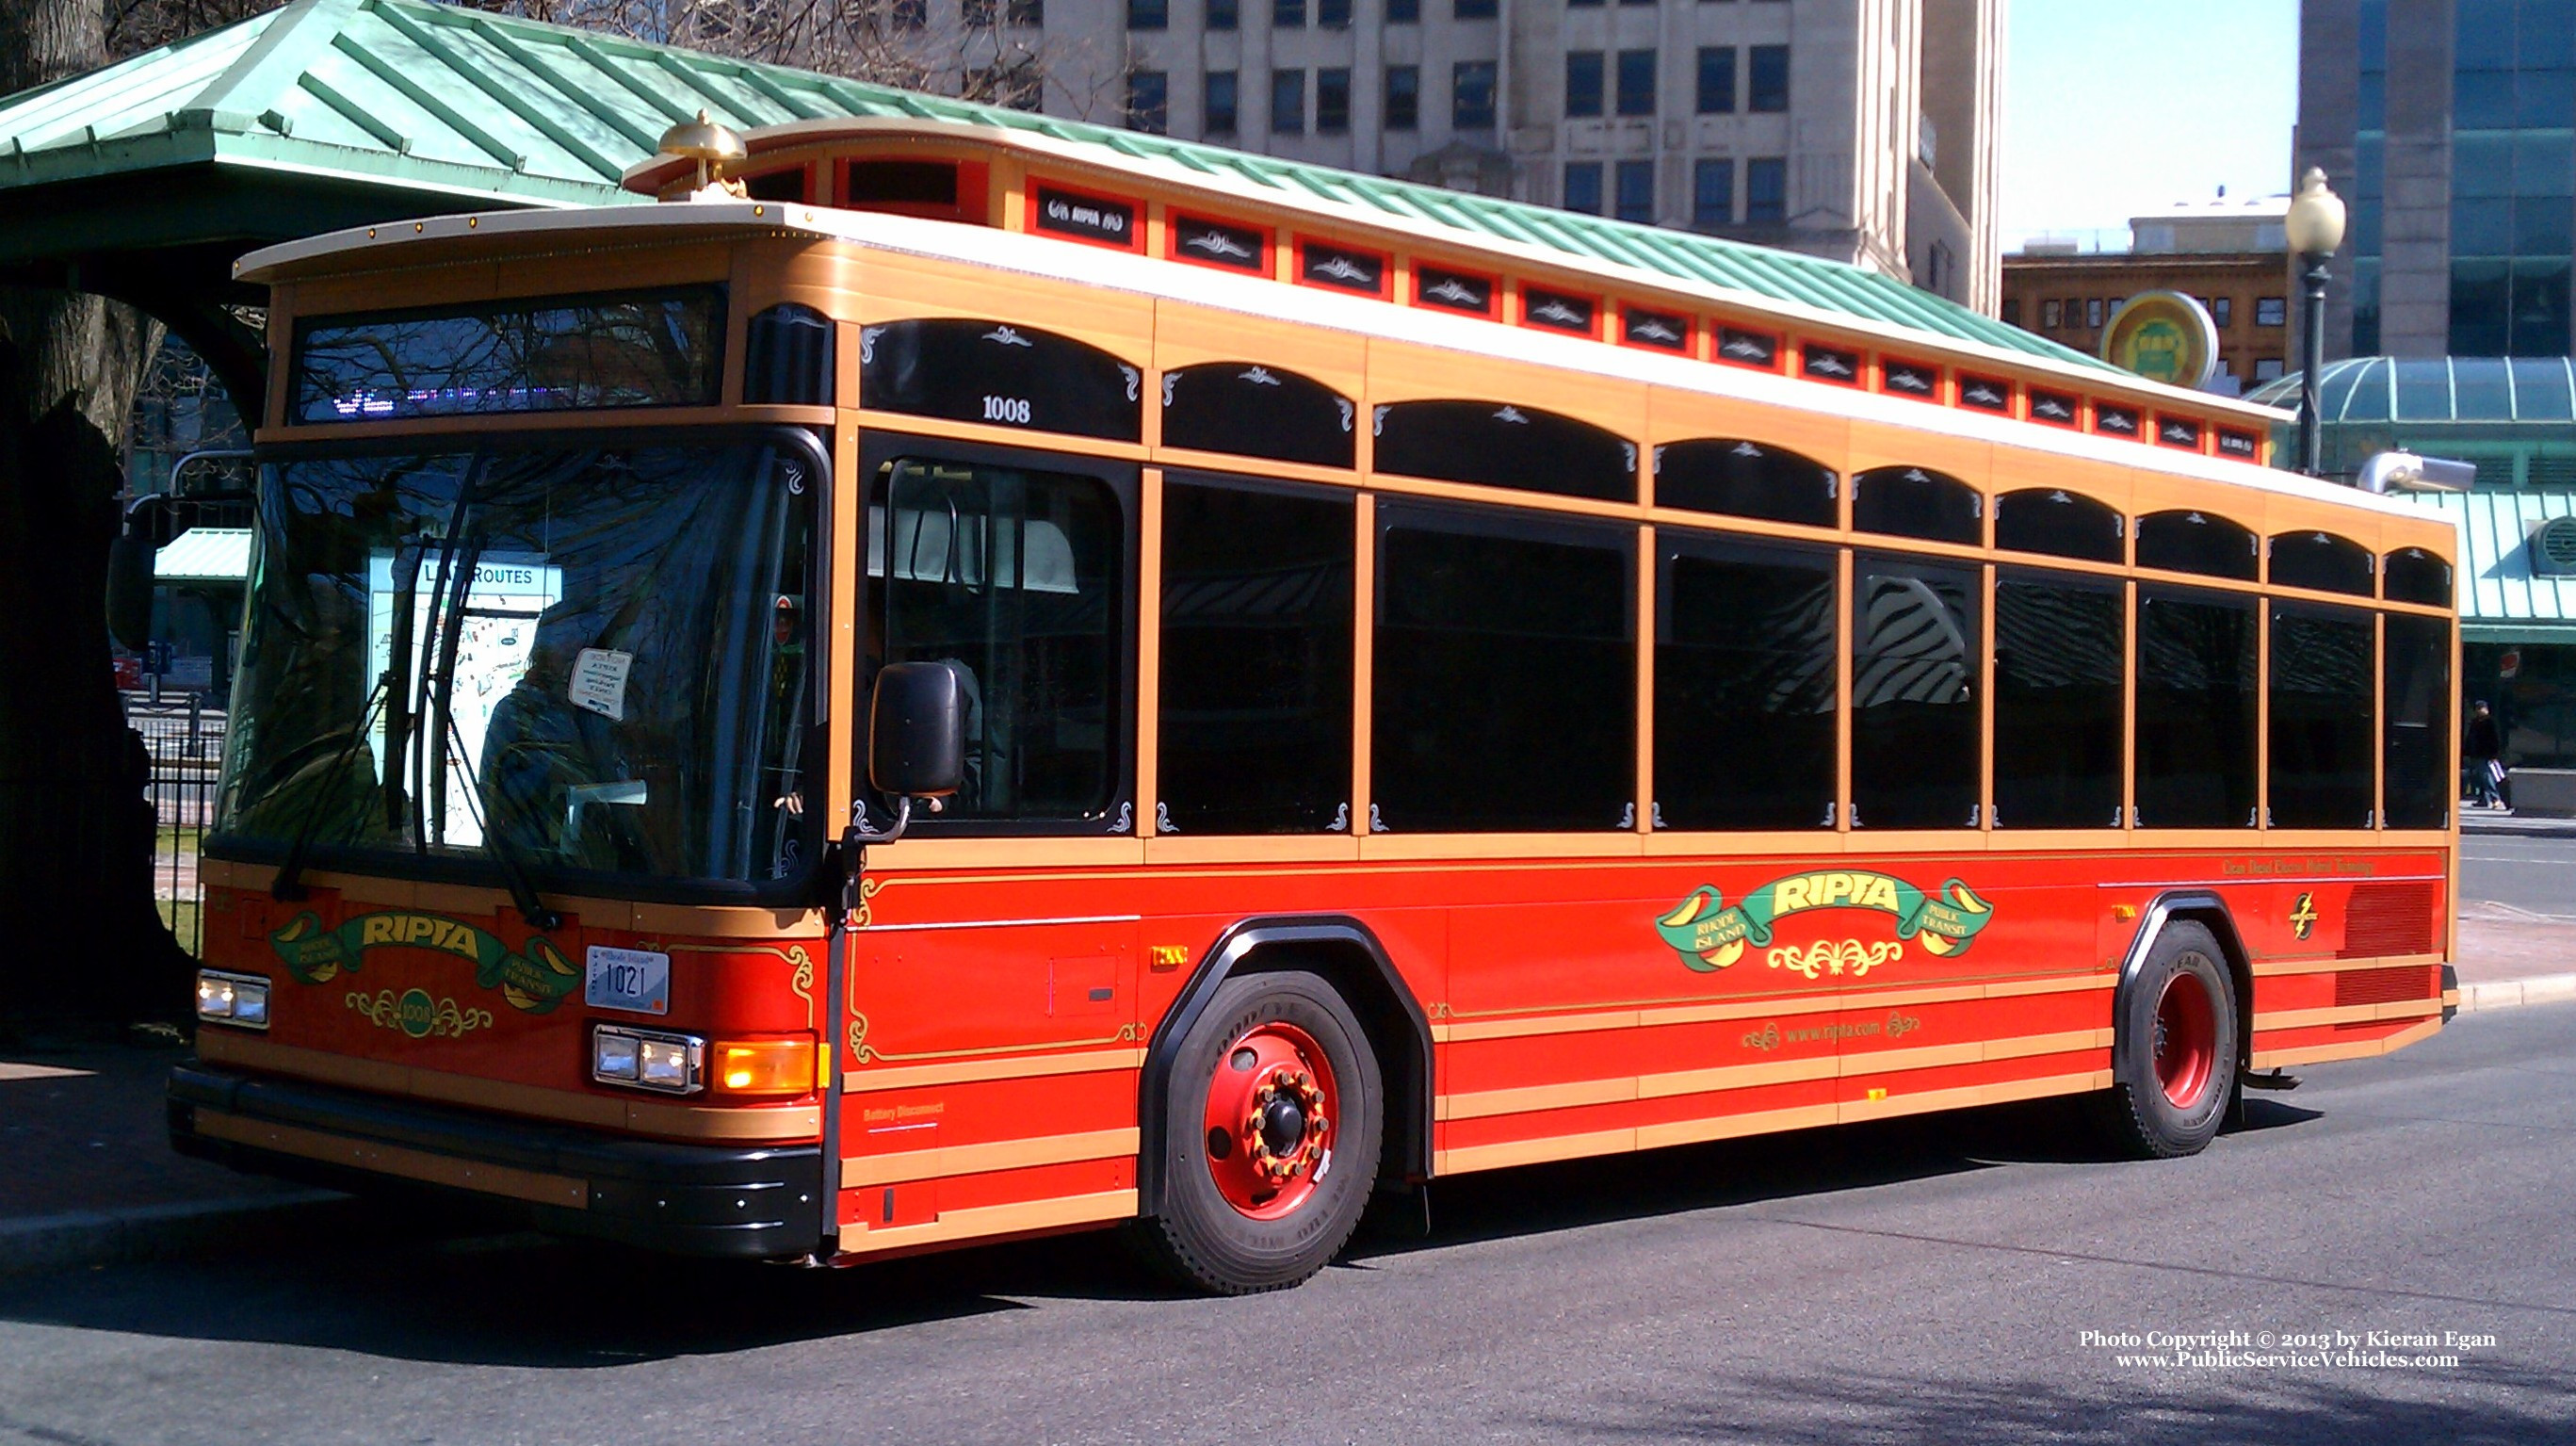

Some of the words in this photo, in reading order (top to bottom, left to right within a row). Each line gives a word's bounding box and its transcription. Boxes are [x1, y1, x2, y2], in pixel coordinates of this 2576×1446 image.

[982, 395, 1030, 424] 1008
[473, 567, 532, 584] ROUTES
[1774, 873, 1899, 916] RIPTA
[1697, 912, 1737, 935] RHODE
[1922, 914, 1968, 935] TRANSIT
[1929, 904, 1960, 922] PUBLIC
[364, 915, 478, 960] RIPTA
[1695, 923, 1746, 949] ISLAND
[607, 964, 645, 997] 1021
[404, 1002, 430, 1024] 1008
[1788, 1022, 1881, 1046] www.ripta.com
